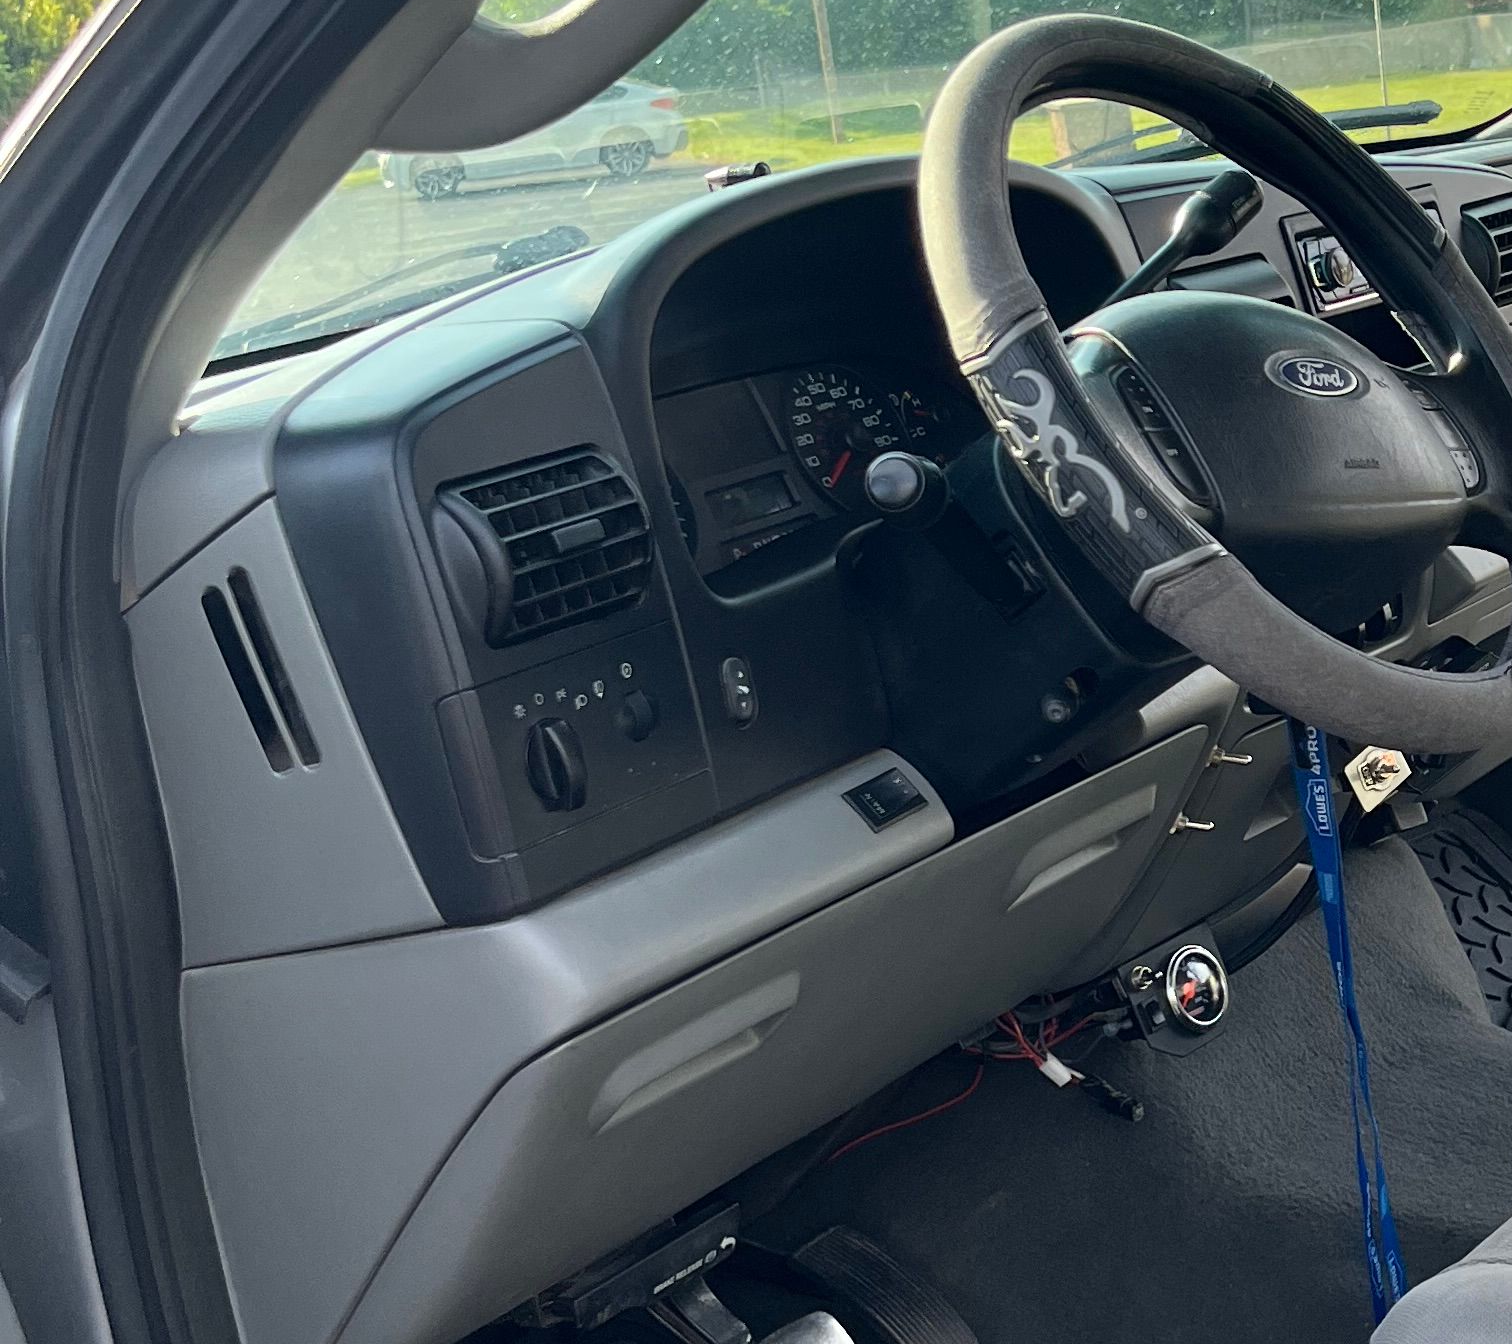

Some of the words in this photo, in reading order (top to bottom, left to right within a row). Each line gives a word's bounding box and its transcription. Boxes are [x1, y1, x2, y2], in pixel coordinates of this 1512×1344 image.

[1296, 361, 1345, 388] Ford
[807, 382, 826, 395] 50
[829, 386, 847, 399] 60
[794, 396, 813, 407] 40
[847, 398, 865, 410] 70
[792, 413, 811, 426] 30
[796, 433, 815, 447] 20
[1316, 785, 1330, 831] LOWE'S
